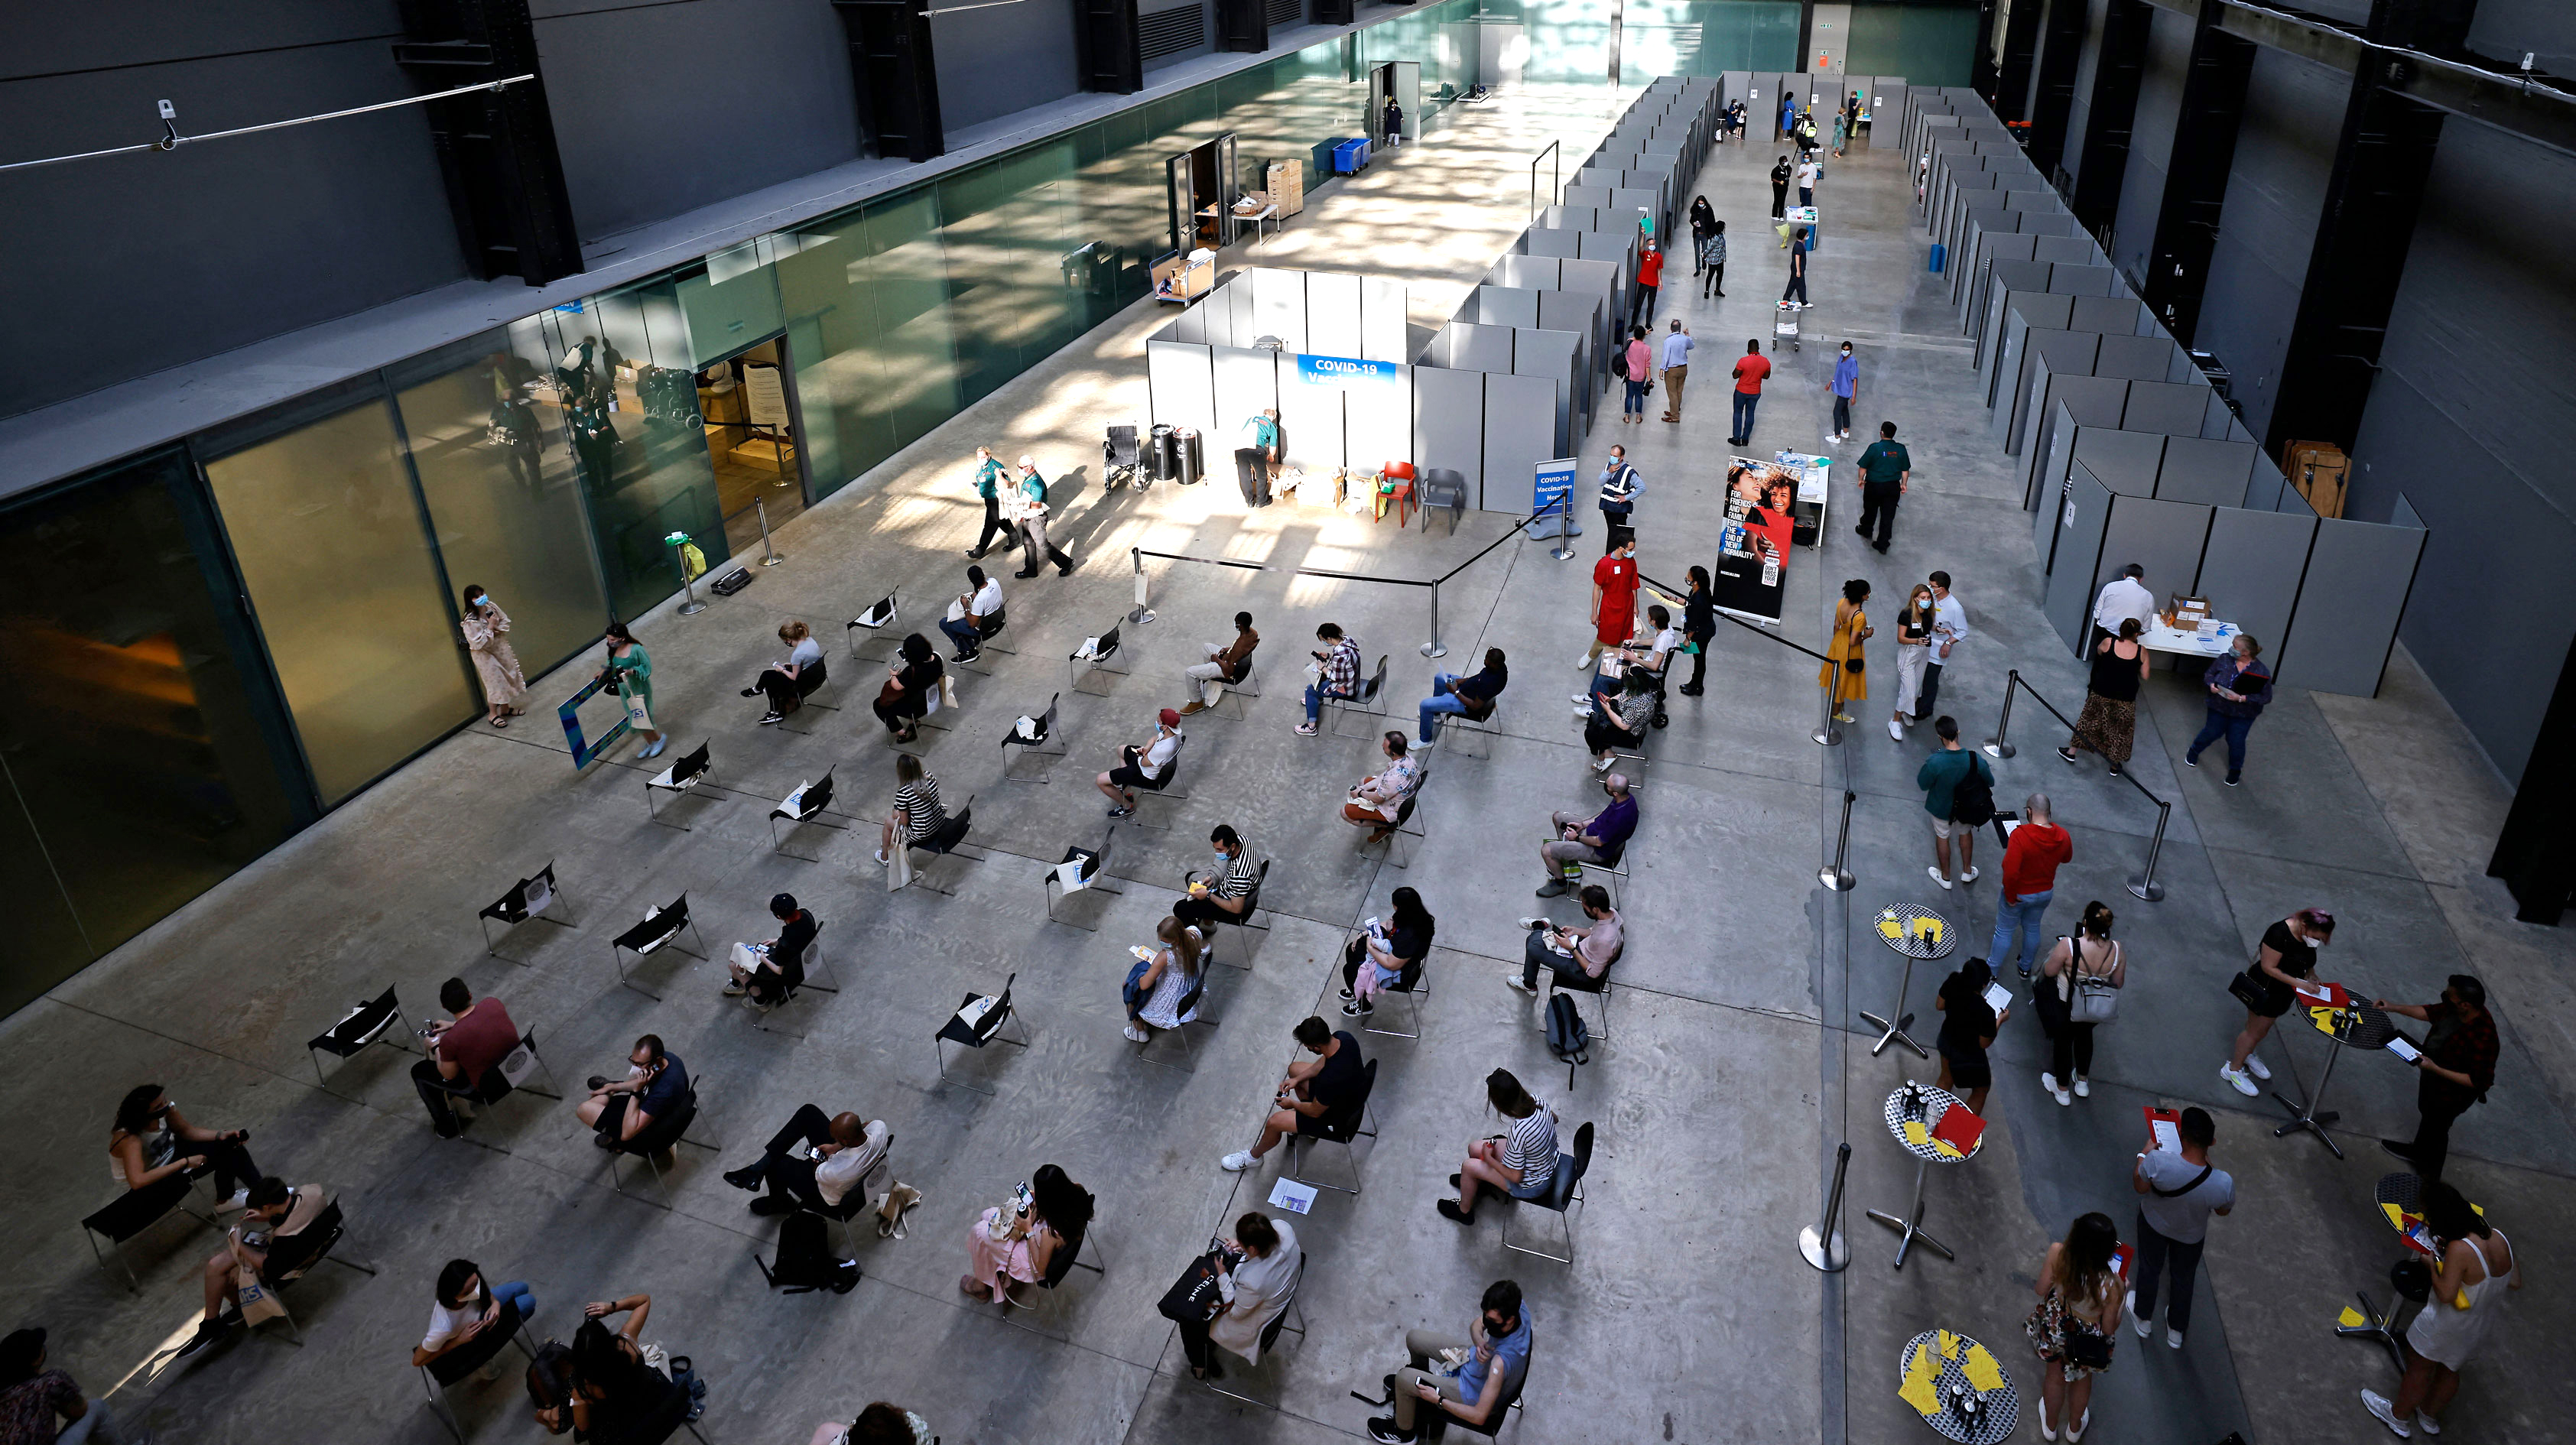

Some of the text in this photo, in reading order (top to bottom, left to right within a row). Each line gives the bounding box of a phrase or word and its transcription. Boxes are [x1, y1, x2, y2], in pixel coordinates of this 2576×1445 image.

[1315, 359, 1378, 375] COVID-19
[1730, 490, 1741, 498] FOR
[1730, 498, 1752, 508] FRIENDS
[1729, 505, 1740, 513] AND
[1728, 511, 1746, 521] FAMILY
[1726, 526, 1736, 534] THE
[1724, 541, 1739, 549] 'NEW
[1723, 547, 1755, 560] NORMALITY'
[1188, 1275, 1214, 1302] CELINE
